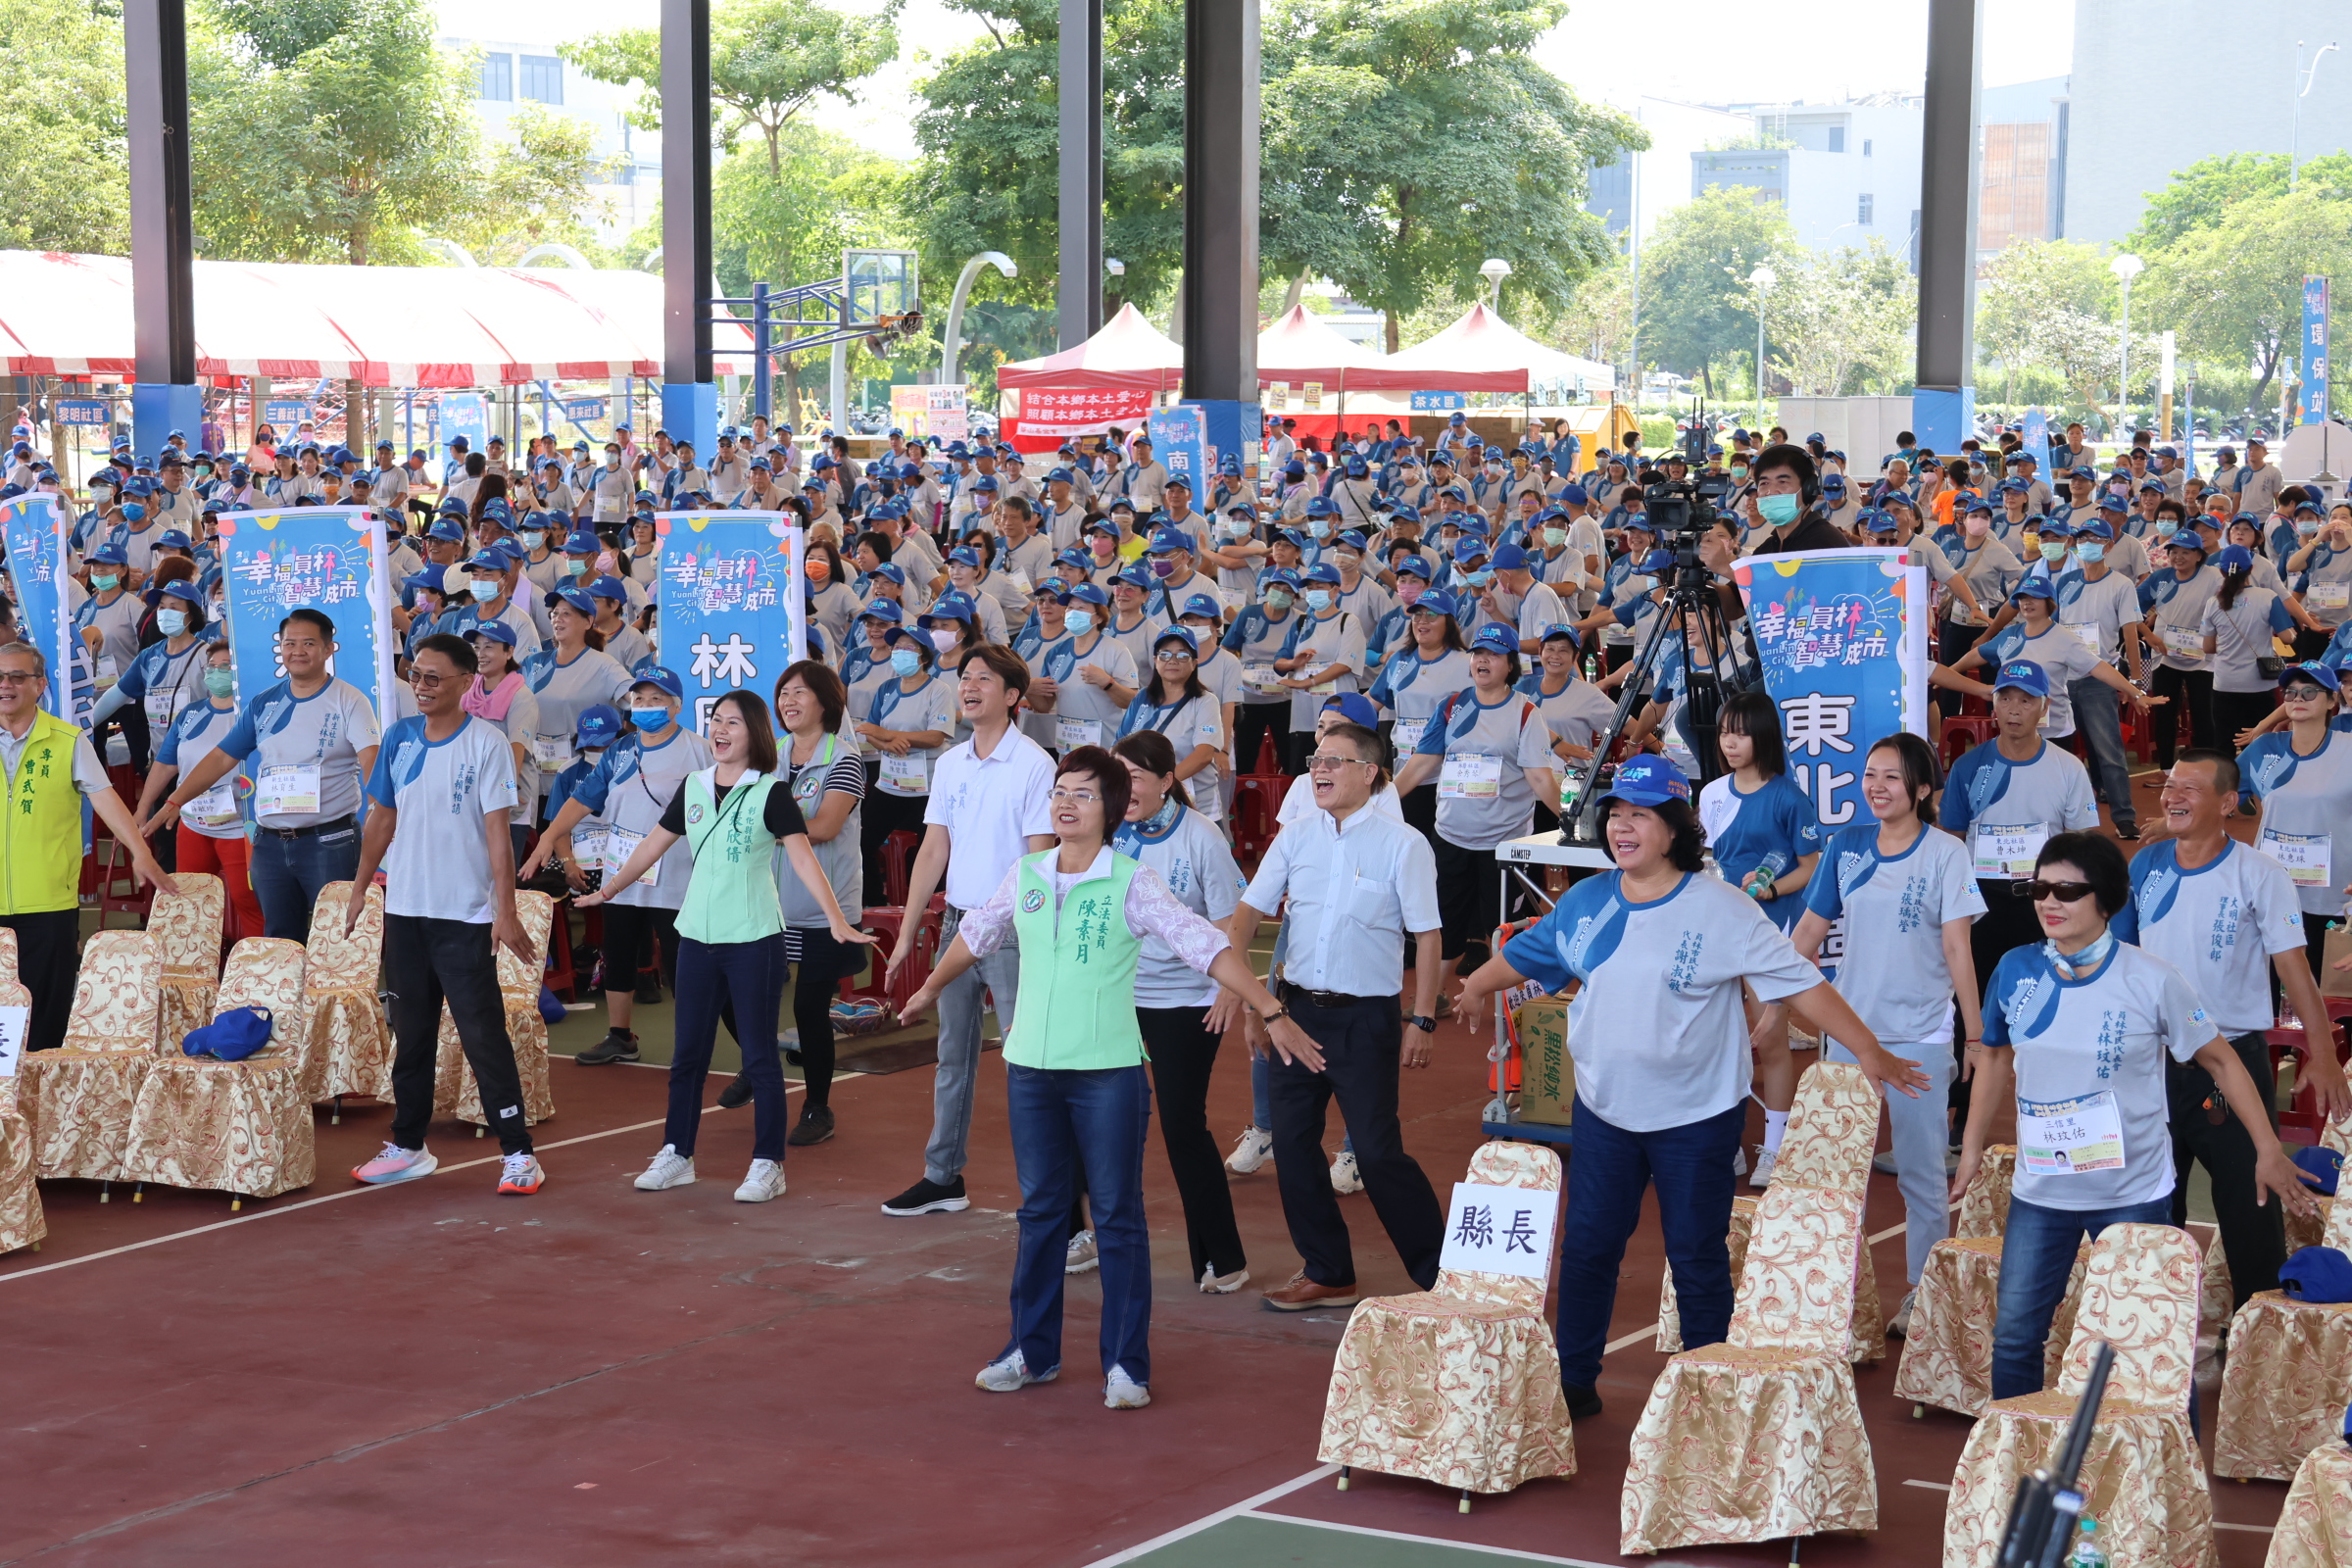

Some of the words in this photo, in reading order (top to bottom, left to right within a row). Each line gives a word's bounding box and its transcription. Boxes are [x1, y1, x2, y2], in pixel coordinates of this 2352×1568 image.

[2310, 322, 2326, 414] 環保站
[58, 407, 104, 423] 黎明社區
[267, 407, 307, 421] 三義社區
[567, 404, 601, 419] 惠來社區
[1025, 404, 1143, 421] 照顧本鄉本土老人
[1026, 390, 1147, 406] 結合本鄉本土愛心
[1414, 396, 1455, 409] 茶水區
[232, 550, 337, 586] 幸福員林
[663, 556, 759, 590] 幸福員林
[243, 583, 284, 597] YuanLin
[284, 574, 359, 605] 智慧城市
[671, 587, 704, 599] YuanLin
[704, 580, 777, 612] 智慧城市
[1755, 601, 1865, 645] 幸福員林
[1795, 628, 1887, 666] 智慧城市
[328, 712, 341, 748] 新生社區
[39, 749, 53, 779] 專員
[464, 765, 475, 795] 三橋里
[20, 760, 36, 815] 曹武賀
[743, 806, 757, 855] 彰化縣議員
[1510, 849, 1531, 859] CAMSTEP
[1995, 846, 2027, 856] 曹木坤
[2278, 844, 2306, 854] 東北社區
[1179, 860, 1191, 893] 三愛里
[2152, 871, 2164, 887] CITY
[1910, 876, 1928, 929] 員林市民代表會
[1074, 899, 1099, 965] 陳素月
[1095, 895, 1113, 951] 立法委員
[2210, 896, 2230, 962] 理事長張俊郎
[2226, 896, 2238, 946] 大明社區
[1668, 929, 1691, 994] 代表謝淑敏
[1682, 932, 1703, 989] 員林市民代表會
[2010, 995, 2031, 1026] YUANLIN
[2026, 980, 2038, 1000] CITY
[2096, 1009, 2114, 1080] 代表林玟佑
[2112, 1010, 2128, 1073] 員林市民代表會
[1544, 1028, 1562, 1102] 黑松純水
[2043, 1127, 2085, 1143] 林玟佑
[2045, 1116, 2077, 1129] 三信里
[1451, 1202, 1538, 1254] 縣長
